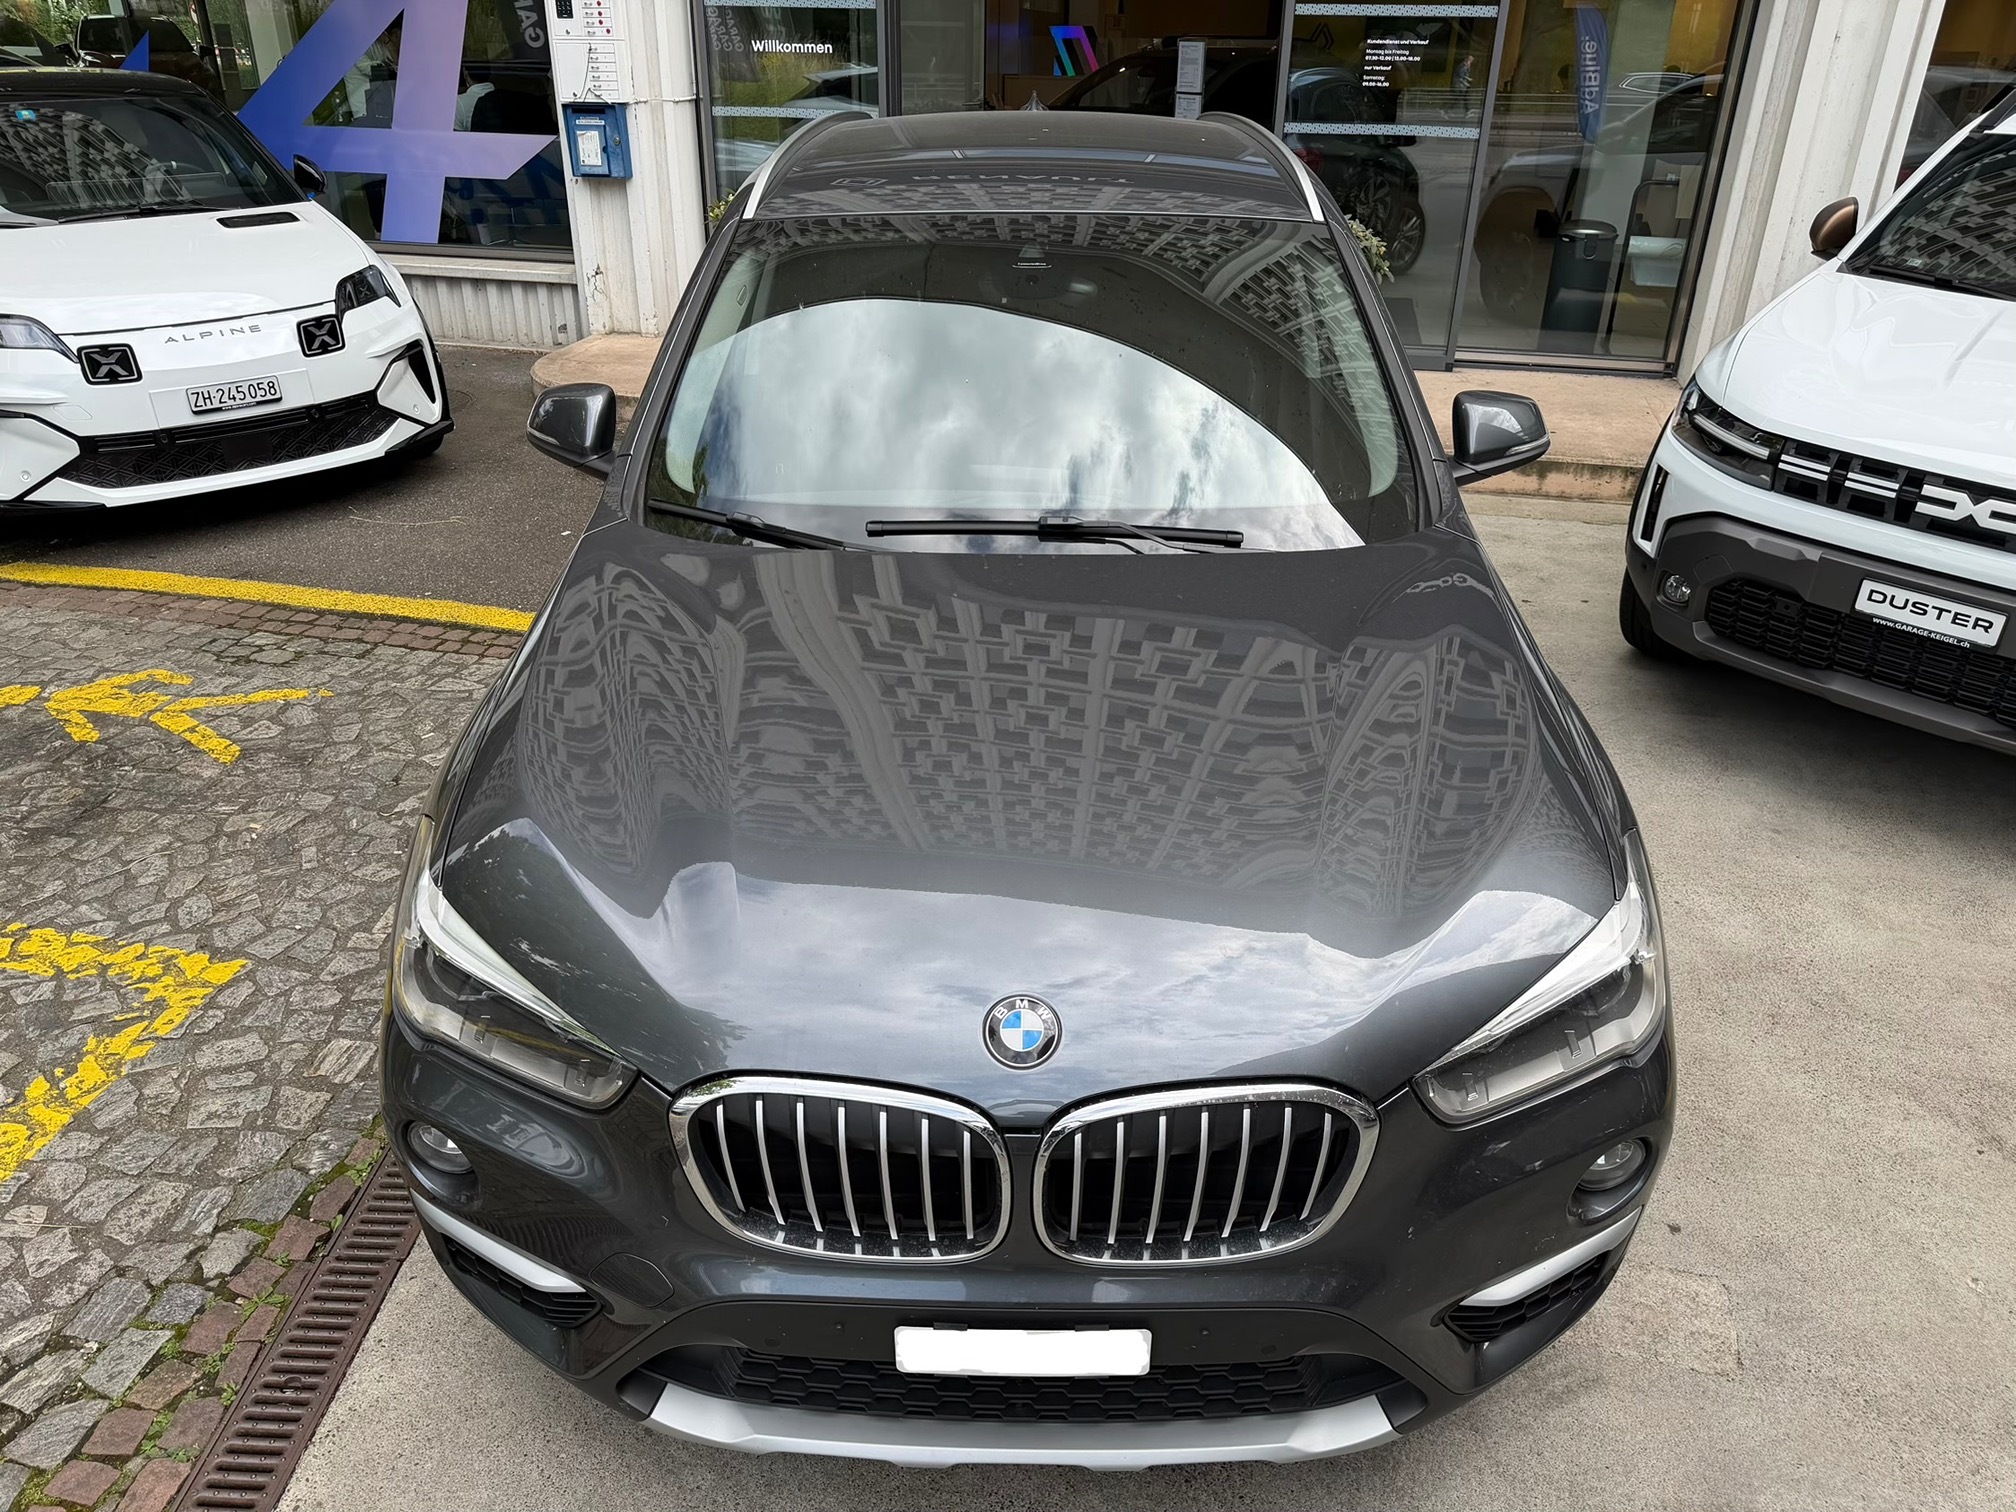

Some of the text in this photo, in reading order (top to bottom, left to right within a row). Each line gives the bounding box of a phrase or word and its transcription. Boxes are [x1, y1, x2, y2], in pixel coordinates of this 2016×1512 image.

[751, 39, 833, 54] Willkommen
[164, 324, 262, 344] ALPINE
[1866, 588, 1994, 635] DUSTER
[1872, 616, 1971, 649] www.GARAGE-KEIGEL.ch
[993, 998, 1052, 1020] BMW
